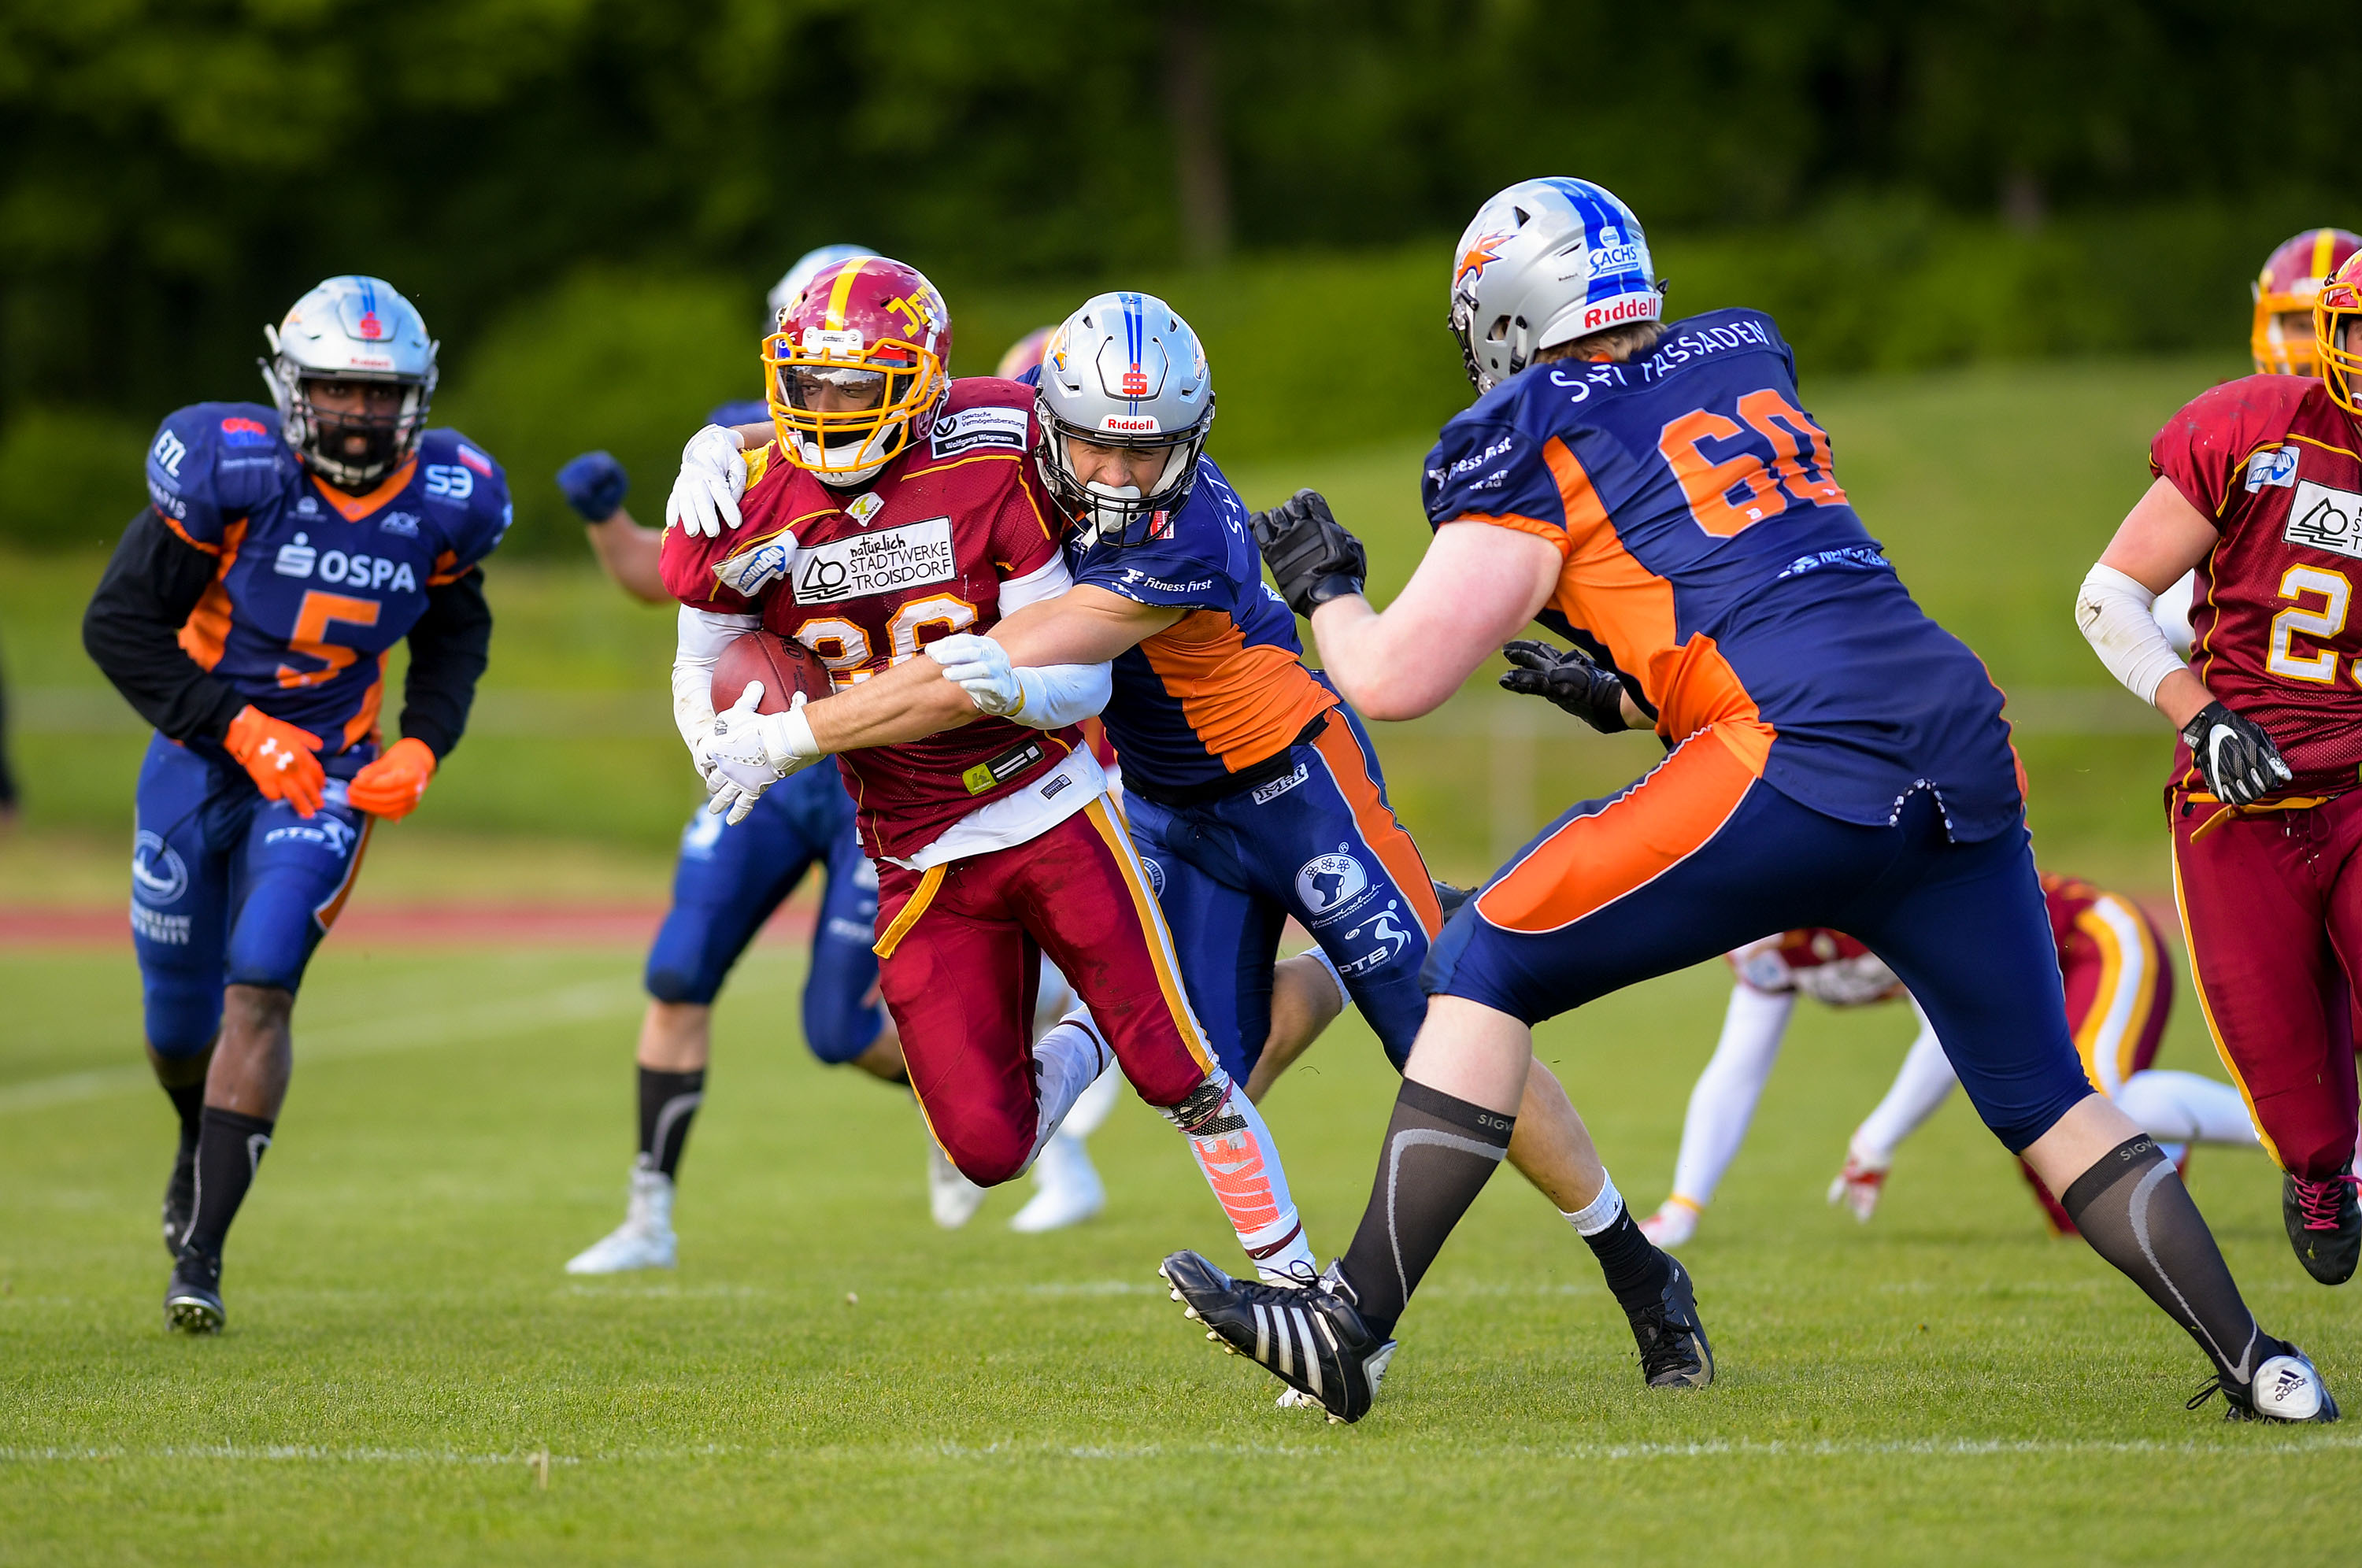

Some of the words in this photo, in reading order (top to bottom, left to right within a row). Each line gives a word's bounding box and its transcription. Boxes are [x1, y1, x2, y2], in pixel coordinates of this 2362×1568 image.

[1588, 246, 1638, 278] SACHS
[1583, 297, 1657, 329] Riddell
[961, 412, 991, 421] Deutsche
[1108, 418, 1153, 430] Riddell
[945, 436, 978, 449] Wolfgang
[1657, 388, 1850, 538] 60
[850, 534, 906, 558] natürlich
[850, 542, 950, 573] STADTWERKE
[318, 549, 416, 594] OSPA
[852, 559, 951, 590] TROISDORF
[276, 589, 382, 689] 5
[1338, 945, 1388, 974] PTB
[2275, 1377, 2308, 1402] adidas
